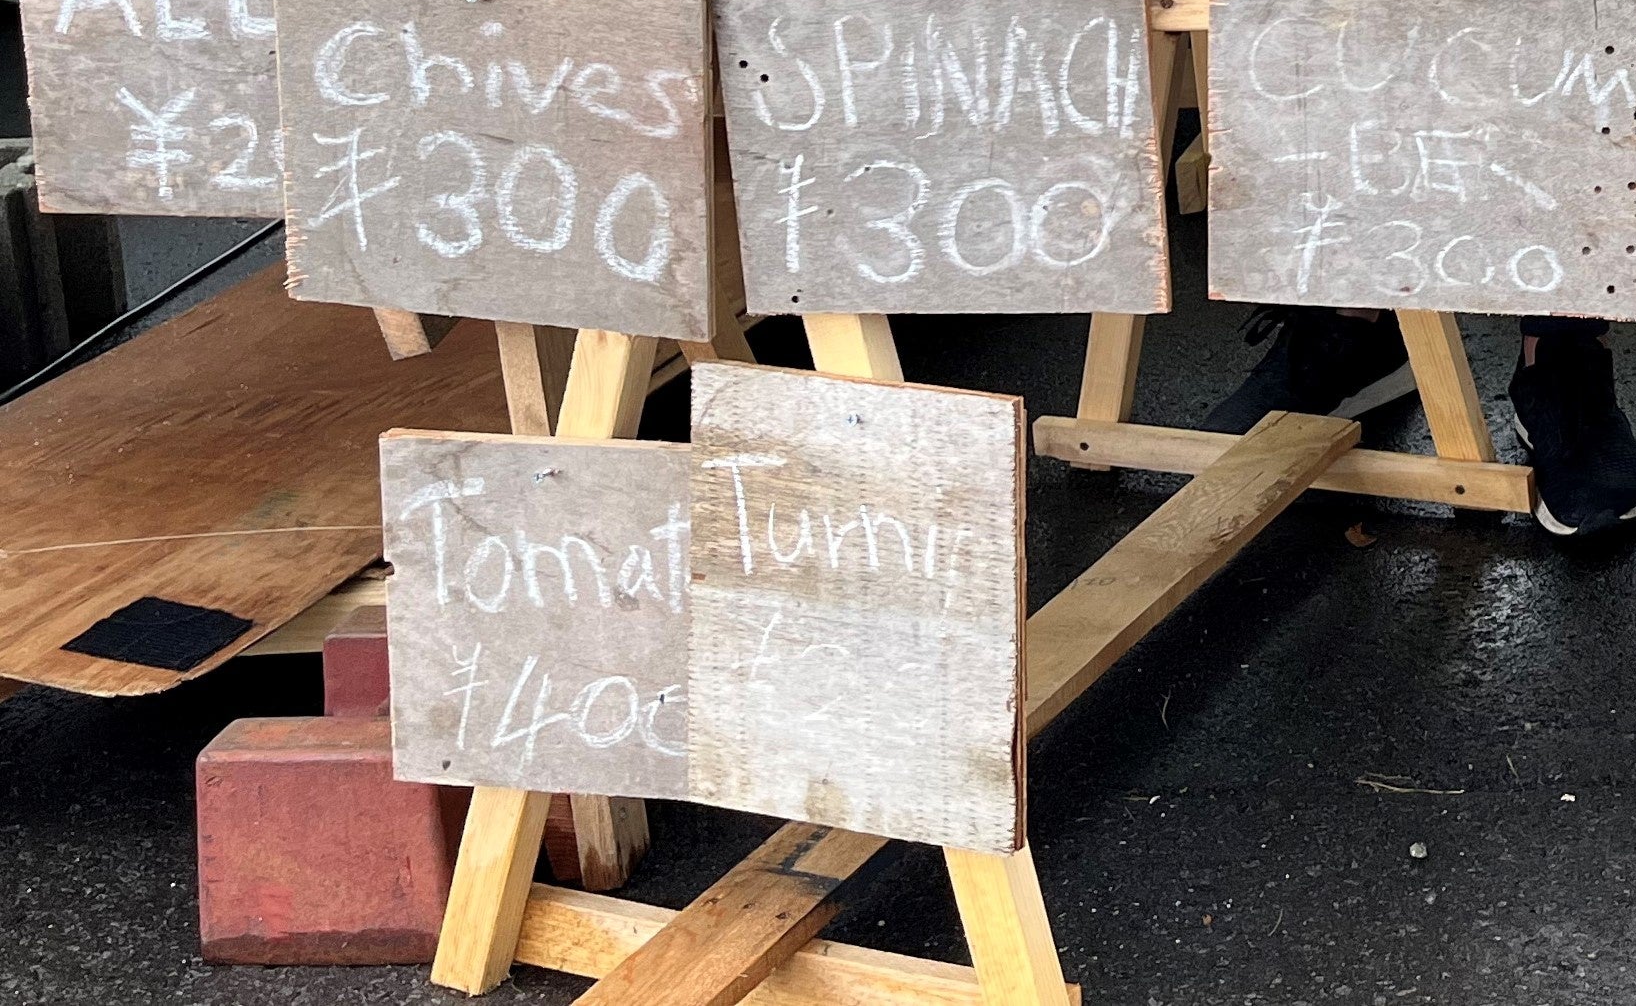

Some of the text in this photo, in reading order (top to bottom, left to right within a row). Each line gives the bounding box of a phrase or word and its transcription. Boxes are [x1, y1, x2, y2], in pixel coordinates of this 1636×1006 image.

[314, 20, 698, 140] Chives
[753, 12, 1141, 140] SPINACH
[115, 85, 285, 202] ¥2
[305, 126, 674, 285] ¥300
[776, 153, 1112, 285] ¥300
